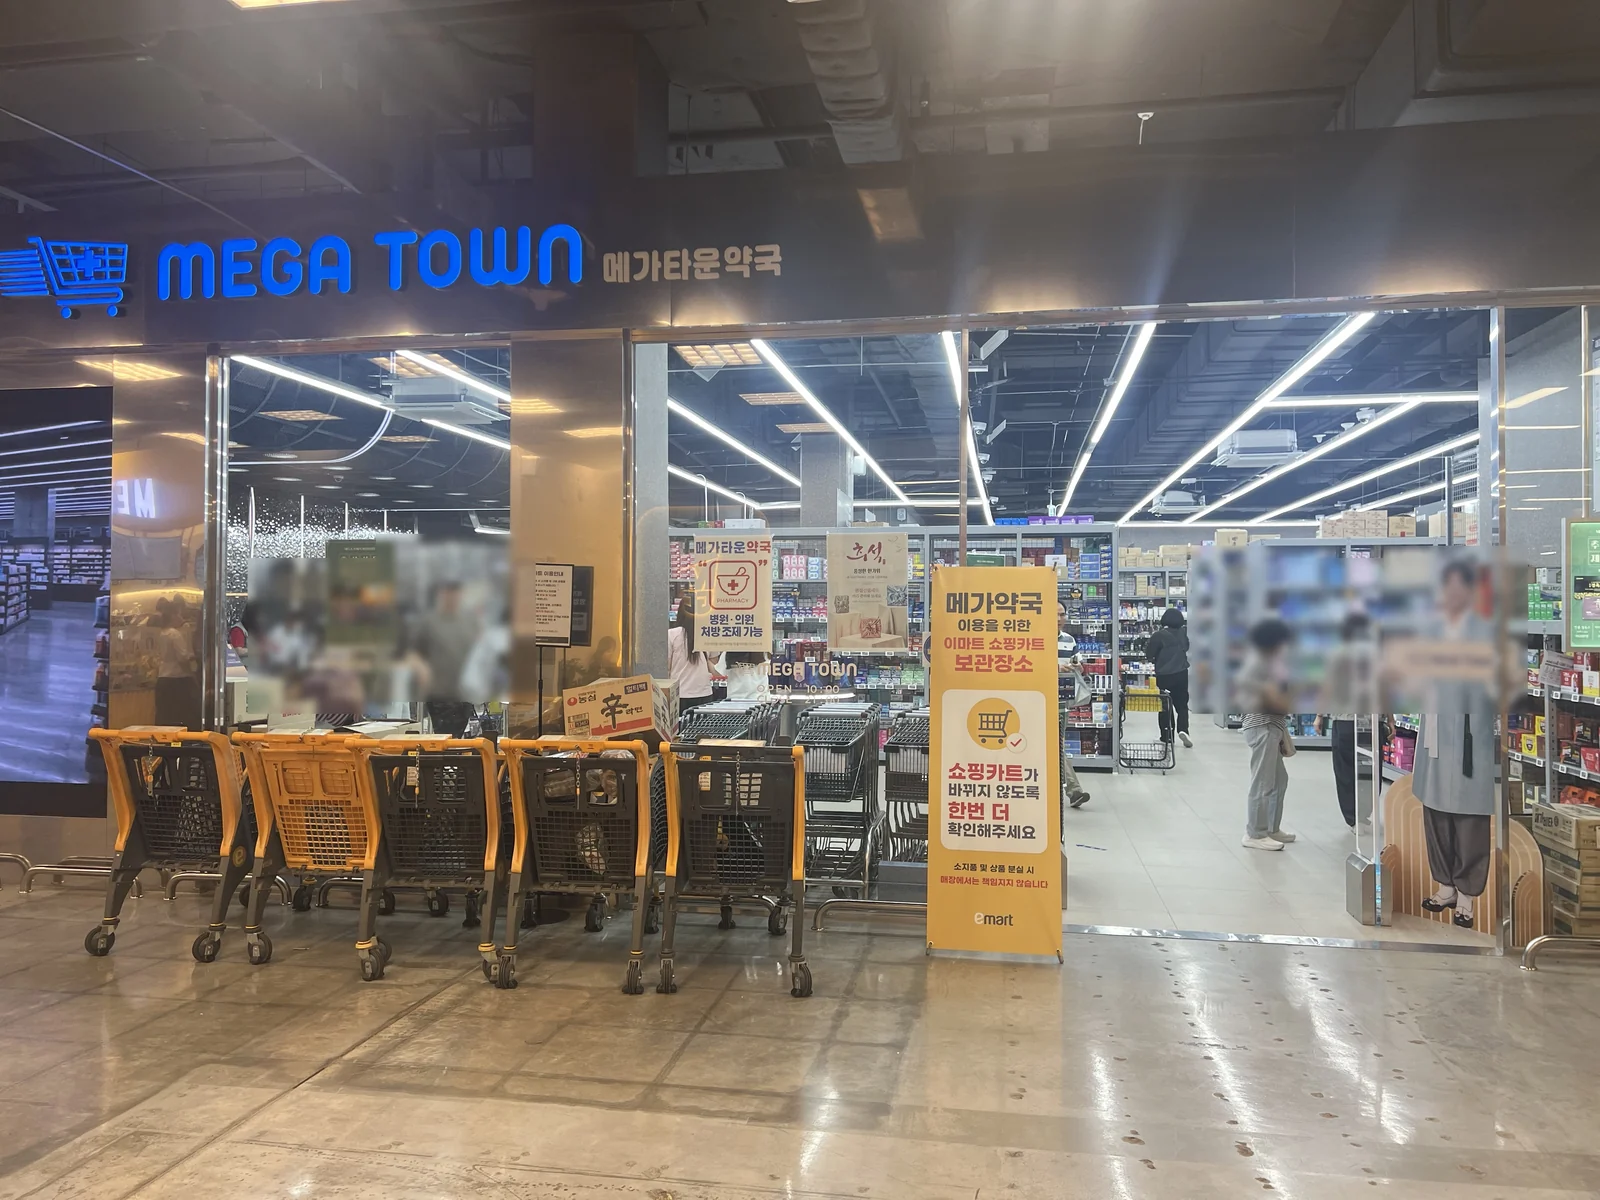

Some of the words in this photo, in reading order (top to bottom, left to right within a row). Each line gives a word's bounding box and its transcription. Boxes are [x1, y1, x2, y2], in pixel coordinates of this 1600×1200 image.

[157, 234, 352, 301] MEGA
[373, 223, 583, 291] TOWN
[602, 243, 782, 284] 메가타운약국
[695, 540, 772, 555] 메가타운약국
[946, 592, 1043, 615] 메가약국
[709, 614, 729, 626] 병원
[735, 614, 754, 626] 의원
[957, 619, 999, 632] 이용을
[1002, 619, 1031, 632] 위한
[701, 626, 721, 638] 처방
[722, 626, 742, 638] 조제
[743, 626, 763, 638] 가능
[944, 637, 985, 651] 이마트
[988, 637, 1045, 651] 쇼핑카트
[808, 662, 857, 677] TOWN
[954, 654, 1034, 673] 보관장소
[757, 684, 792, 694] OPEN
[578, 693, 597, 704] 농심
[625, 706, 643, 715] 라면
[948, 762, 1039, 783] 쇼핑카트가
[948, 783, 991, 799] 바뀌지
[995, 784, 1040, 800] 않도록
[947, 801, 985, 821] 한번
[991, 803, 1010, 822] 더
[947, 822, 1036, 840] 확인해주세요
[953, 862, 977, 872] 소지품
[979, 863, 988, 873] 및
[989, 864, 1006, 874] 상품
[1007, 864, 1024, 875] 분실
[1026, 866, 1034, 875] 시
[940, 875, 980, 886] 매장에서는
[982, 877, 1014, 888] 책임지지
[1015, 879, 1049, 889] 않습니다
[974, 912, 1014, 927] emart
